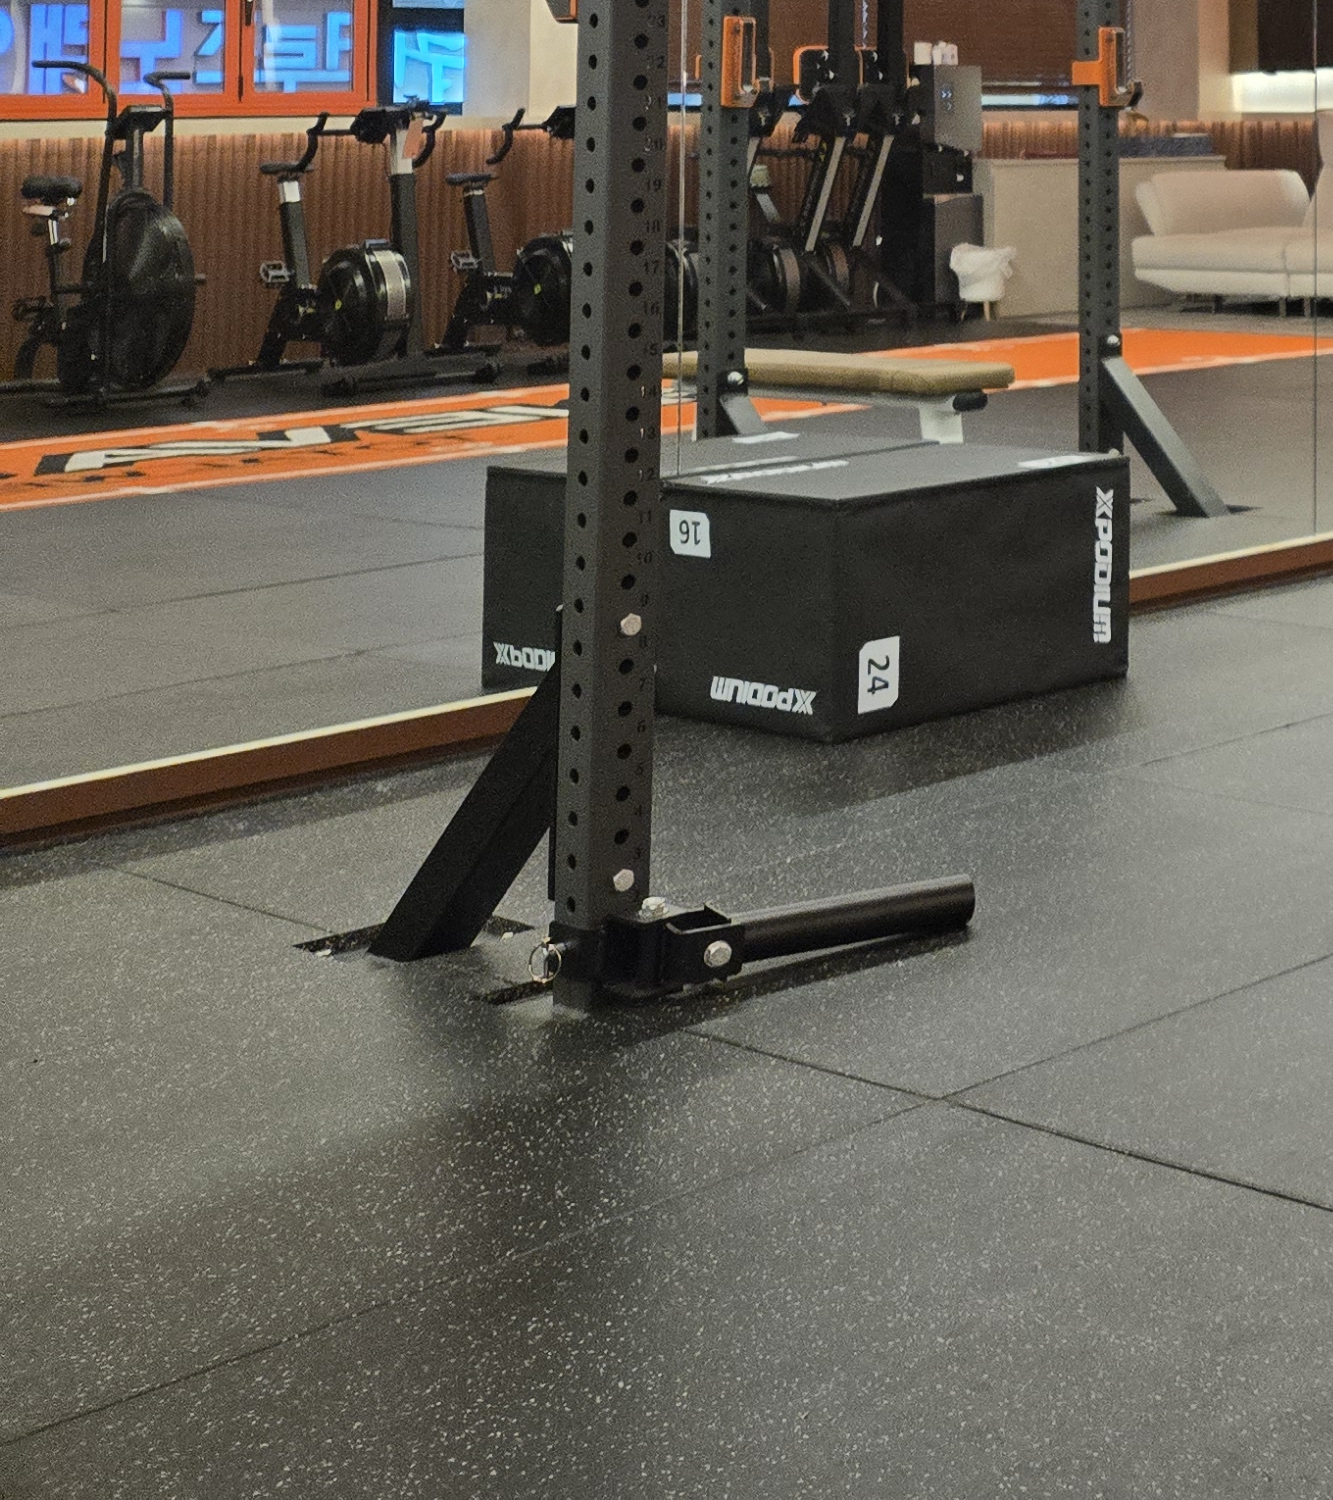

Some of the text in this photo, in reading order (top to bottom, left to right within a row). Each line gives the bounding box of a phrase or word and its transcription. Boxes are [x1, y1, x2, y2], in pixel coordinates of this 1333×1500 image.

[679, 519, 701, 546] 16
[1091, 486, 1115, 644] XPODIUM
[709, 675, 817, 716] XPODIUM
[866, 654, 891, 696] 24
